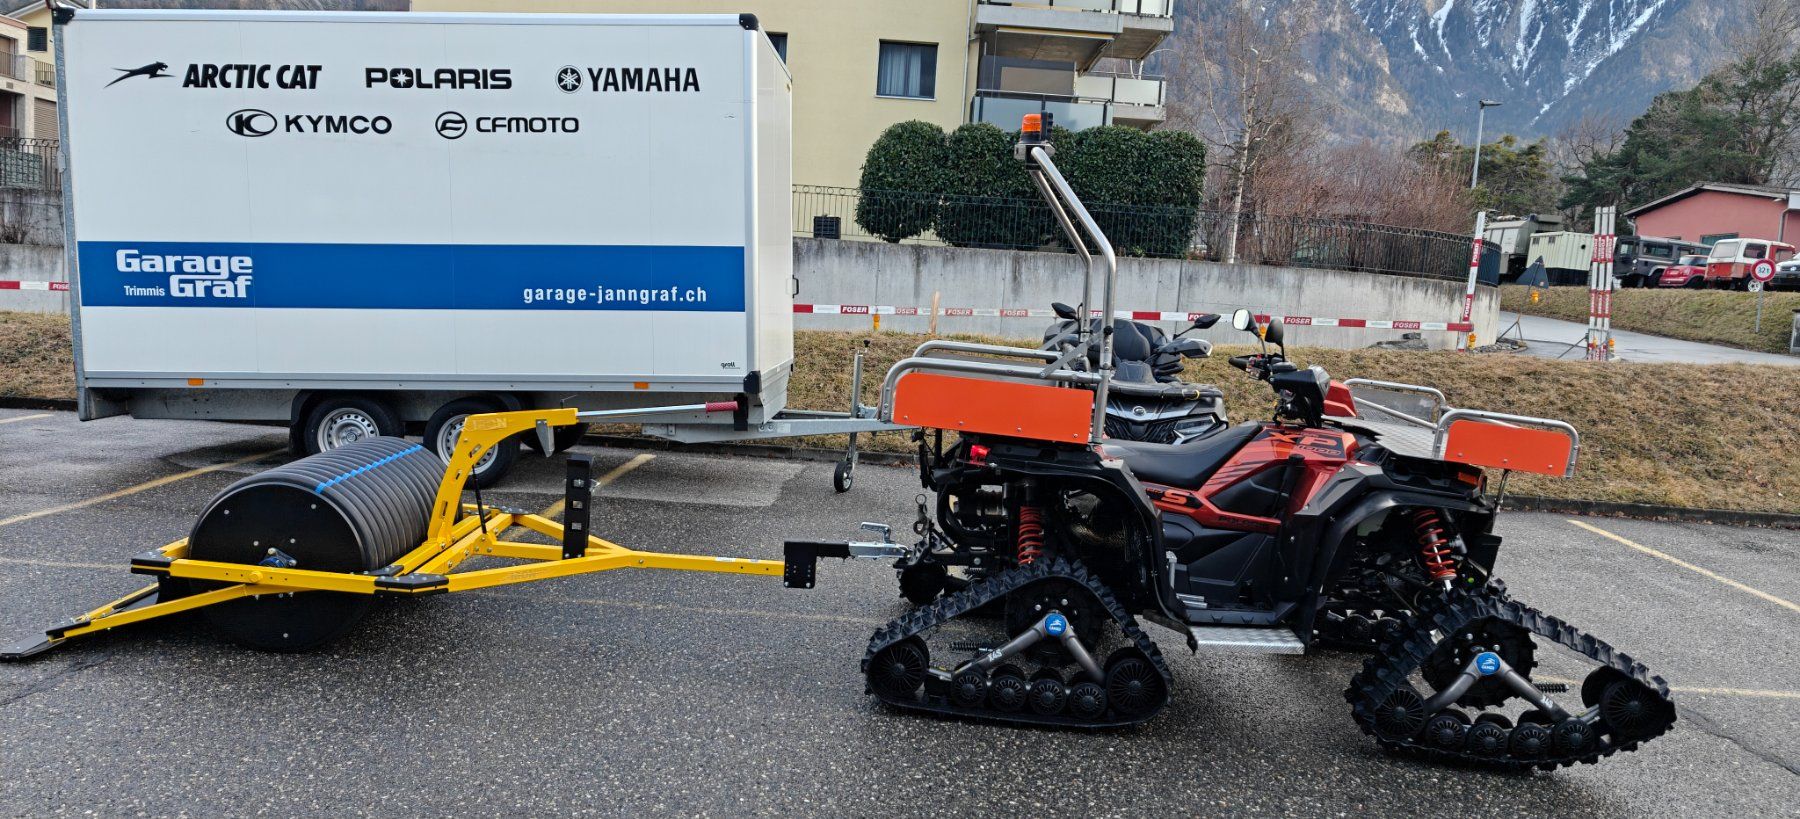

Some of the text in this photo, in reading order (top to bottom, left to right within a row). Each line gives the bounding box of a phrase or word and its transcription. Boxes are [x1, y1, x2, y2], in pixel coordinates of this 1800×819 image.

[182, 63, 323, 90] ARCTIC CAT
[365, 67, 513, 90] POLARIS
[587, 67, 700, 92] YAMAHA
[285, 115, 392, 135] KYMCO
[475, 116, 580, 133] CFMOTO
[116, 249, 253, 280] Garage
[123, 285, 166, 297] Trimmis
[169, 274, 253, 298] Graf
[523, 286, 707, 305] garage-janngraf.ch
[1298, 445, 1341, 455] 1000
